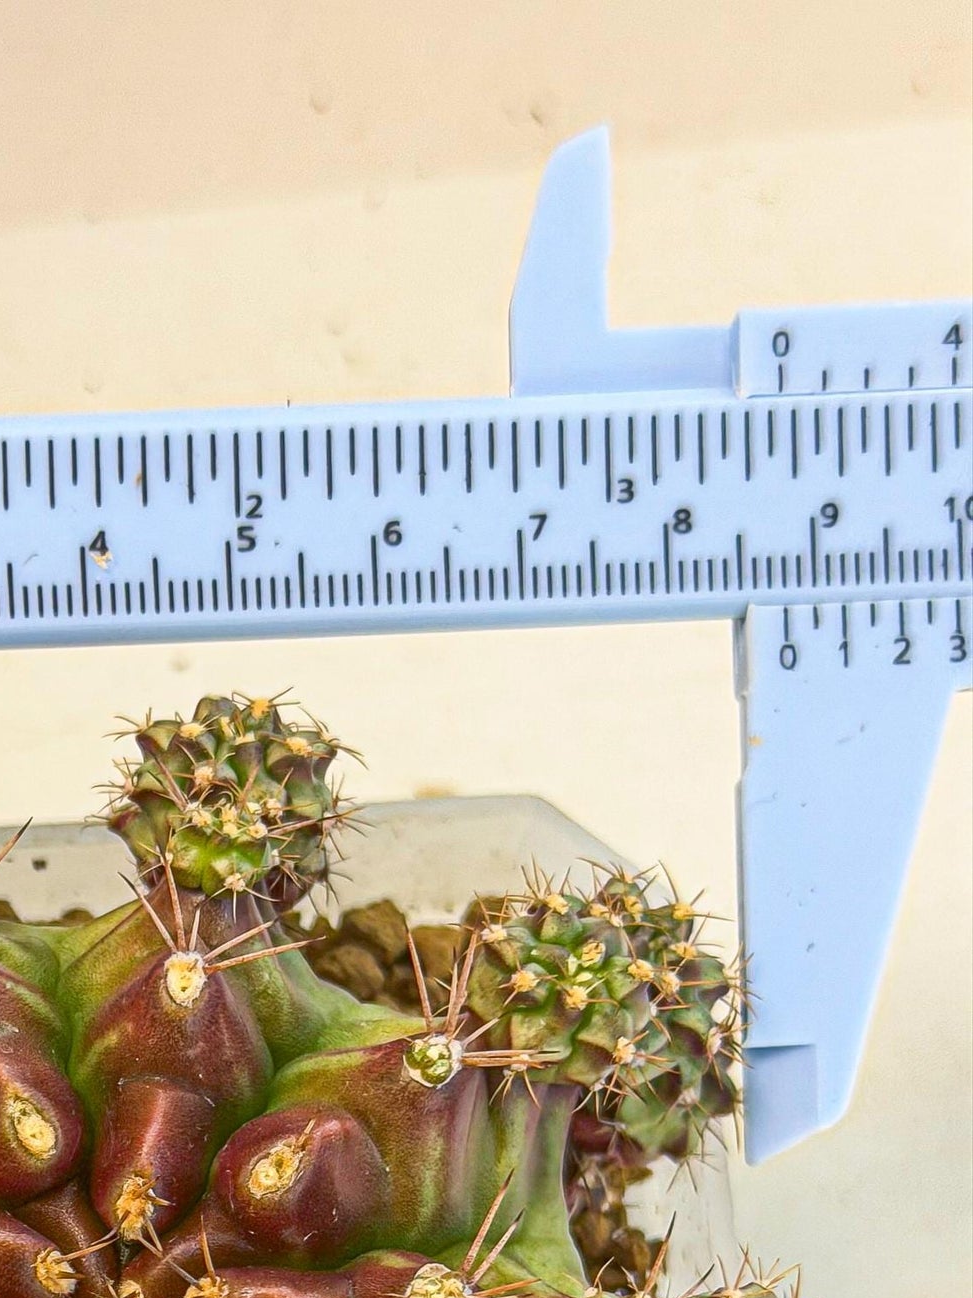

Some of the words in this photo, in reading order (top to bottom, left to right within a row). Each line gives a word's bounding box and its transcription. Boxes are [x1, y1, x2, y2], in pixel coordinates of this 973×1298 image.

[771, 330, 791, 358] 0
[941, 323, 964, 351] 4
[244, 493, 264, 520] 2
[616, 477, 635, 504] 3
[88, 529, 110, 557] 4
[236, 524, 257, 553] 5
[382, 519, 403, 547] 6
[528, 512, 548, 542] 7
[671, 507, 693, 535] 8
[819, 501, 840, 529] 9
[778, 643, 798, 671] 0
[837, 640, 850, 669] 1
[891, 637, 912, 666] 2
[948, 635, 968, 663] 3
